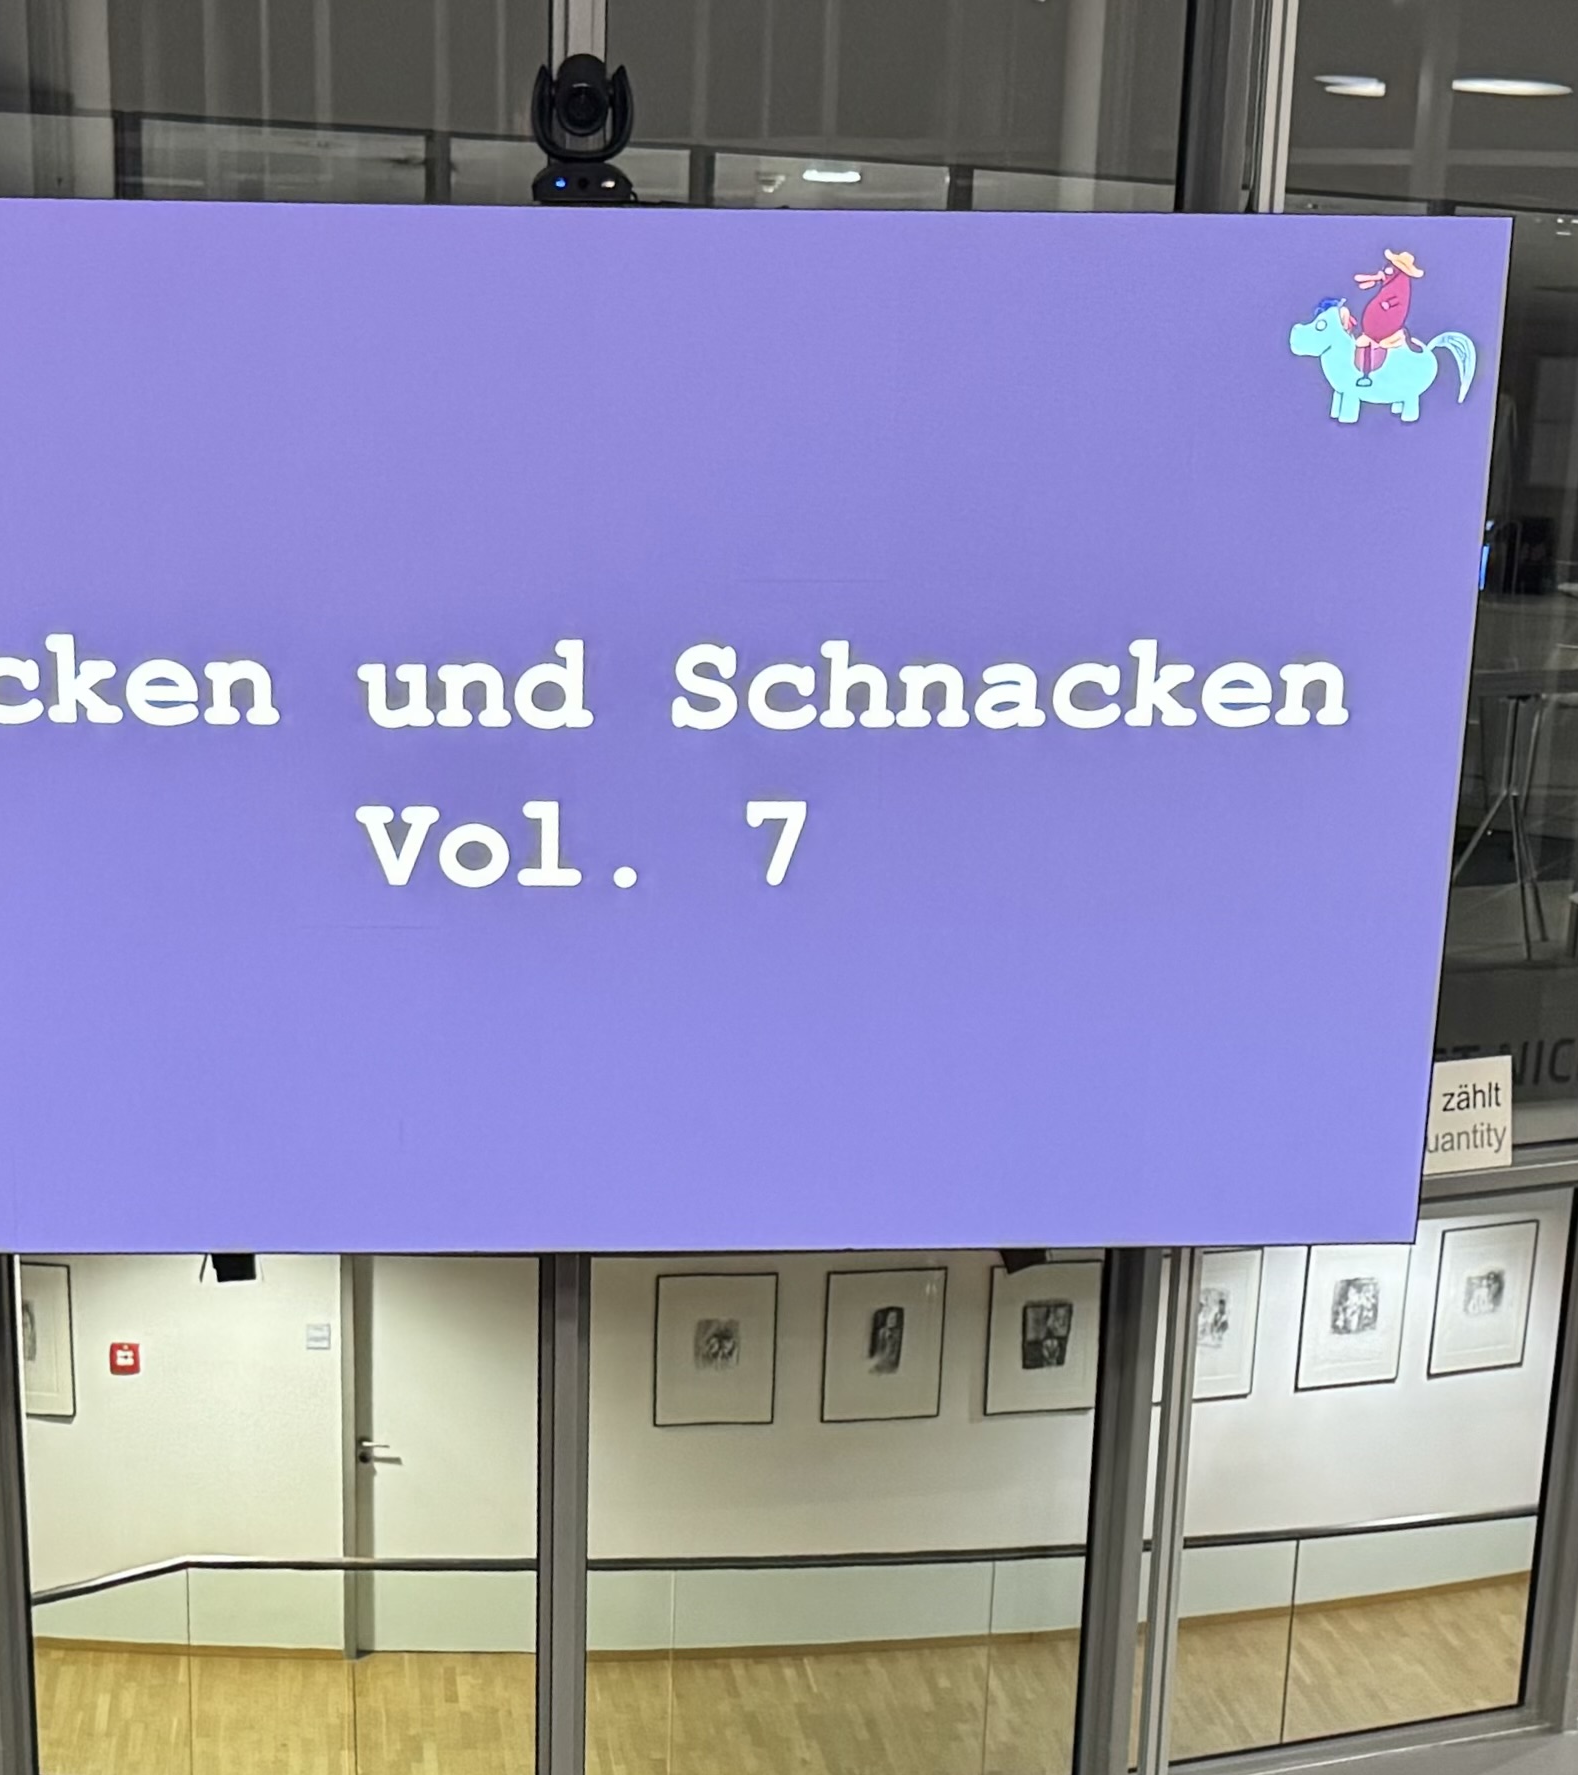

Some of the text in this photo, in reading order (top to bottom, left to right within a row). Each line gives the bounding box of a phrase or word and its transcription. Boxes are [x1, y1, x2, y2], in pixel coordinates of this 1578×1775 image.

[358, 640, 593, 729] und
[672, 640, 1348, 729] Schnacken
[356, 802, 806, 887] Vol. 7
[1442, 1081, 1502, 1112] zählt
